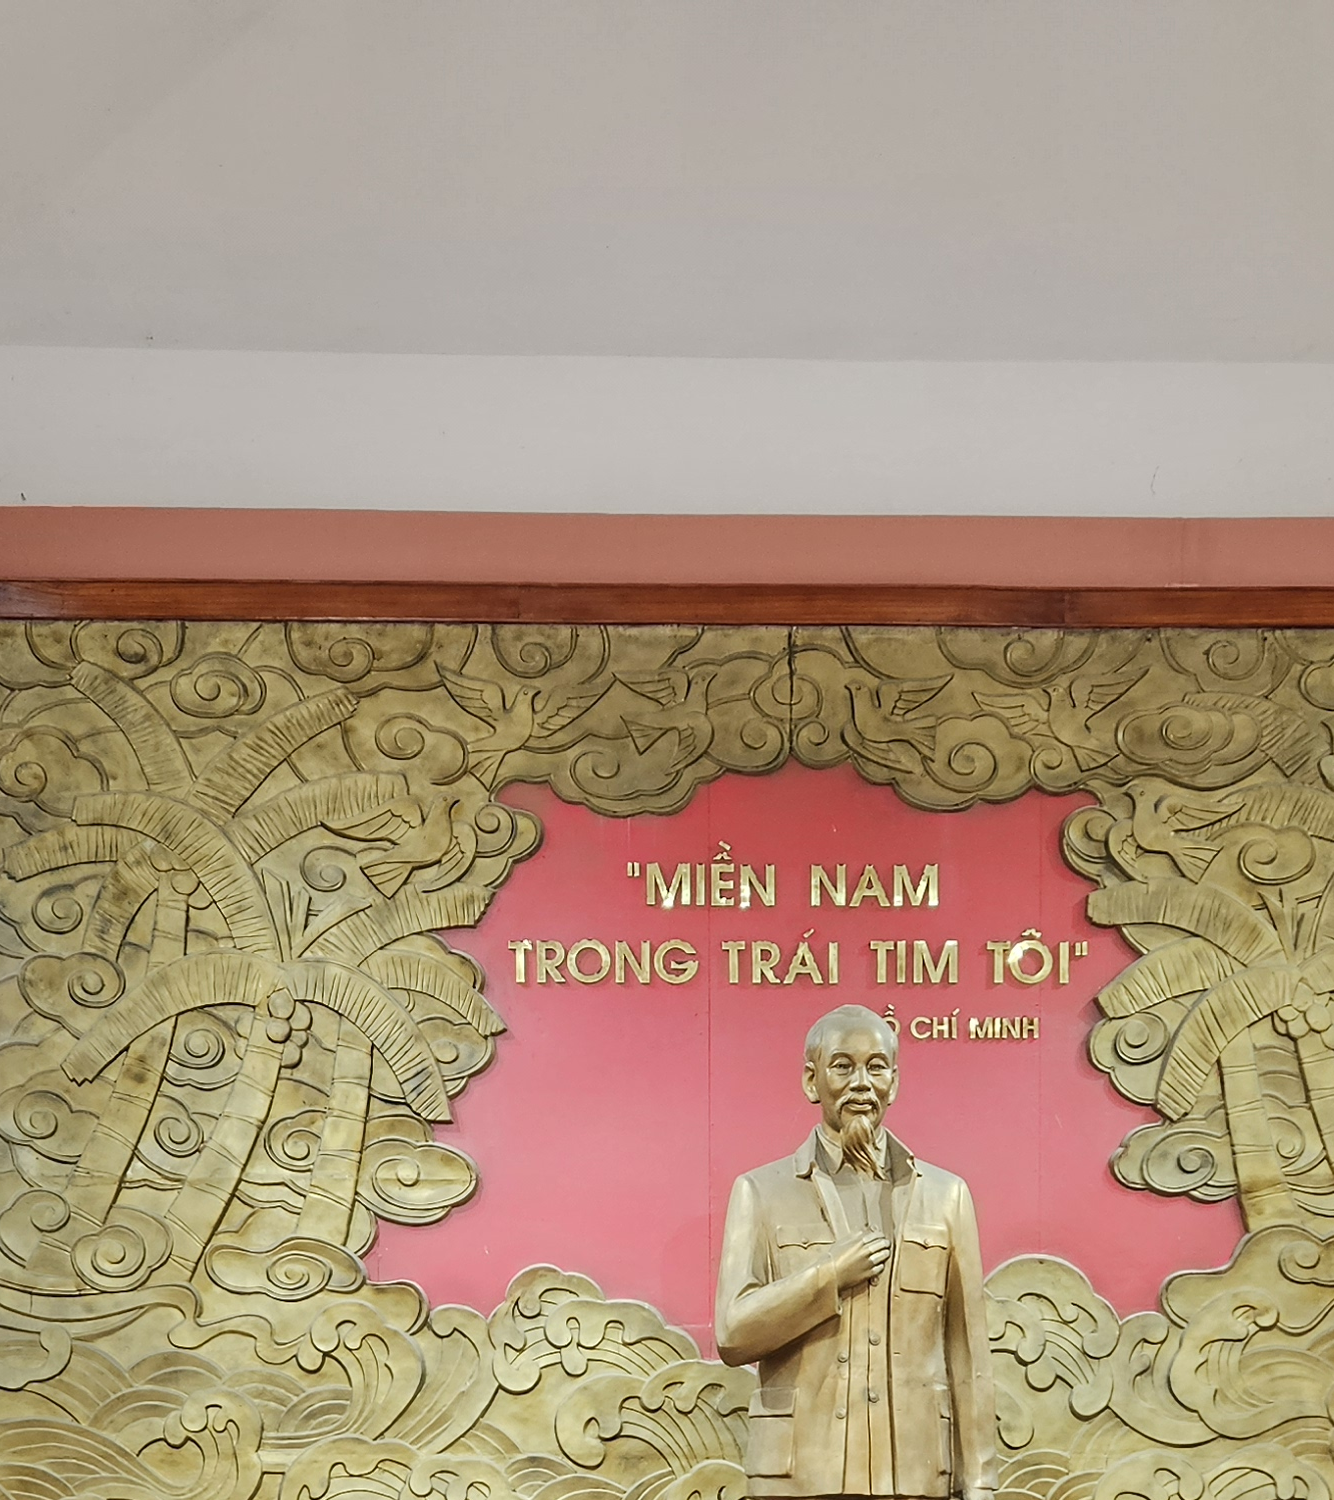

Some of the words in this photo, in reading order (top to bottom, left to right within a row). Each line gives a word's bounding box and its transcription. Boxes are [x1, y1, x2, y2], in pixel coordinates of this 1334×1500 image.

[626, 842, 776, 907] "MIỀN
[810, 863, 940, 907] NAM
[507, 938, 699, 985] TRONG
[721, 928, 839, 985] TRÁI
[869, 939, 959, 984] TIM
[986, 928, 1089, 984] TÔI"
[909, 1007, 960, 1039] CHÍ
[969, 1016, 1040, 1039] MINH
